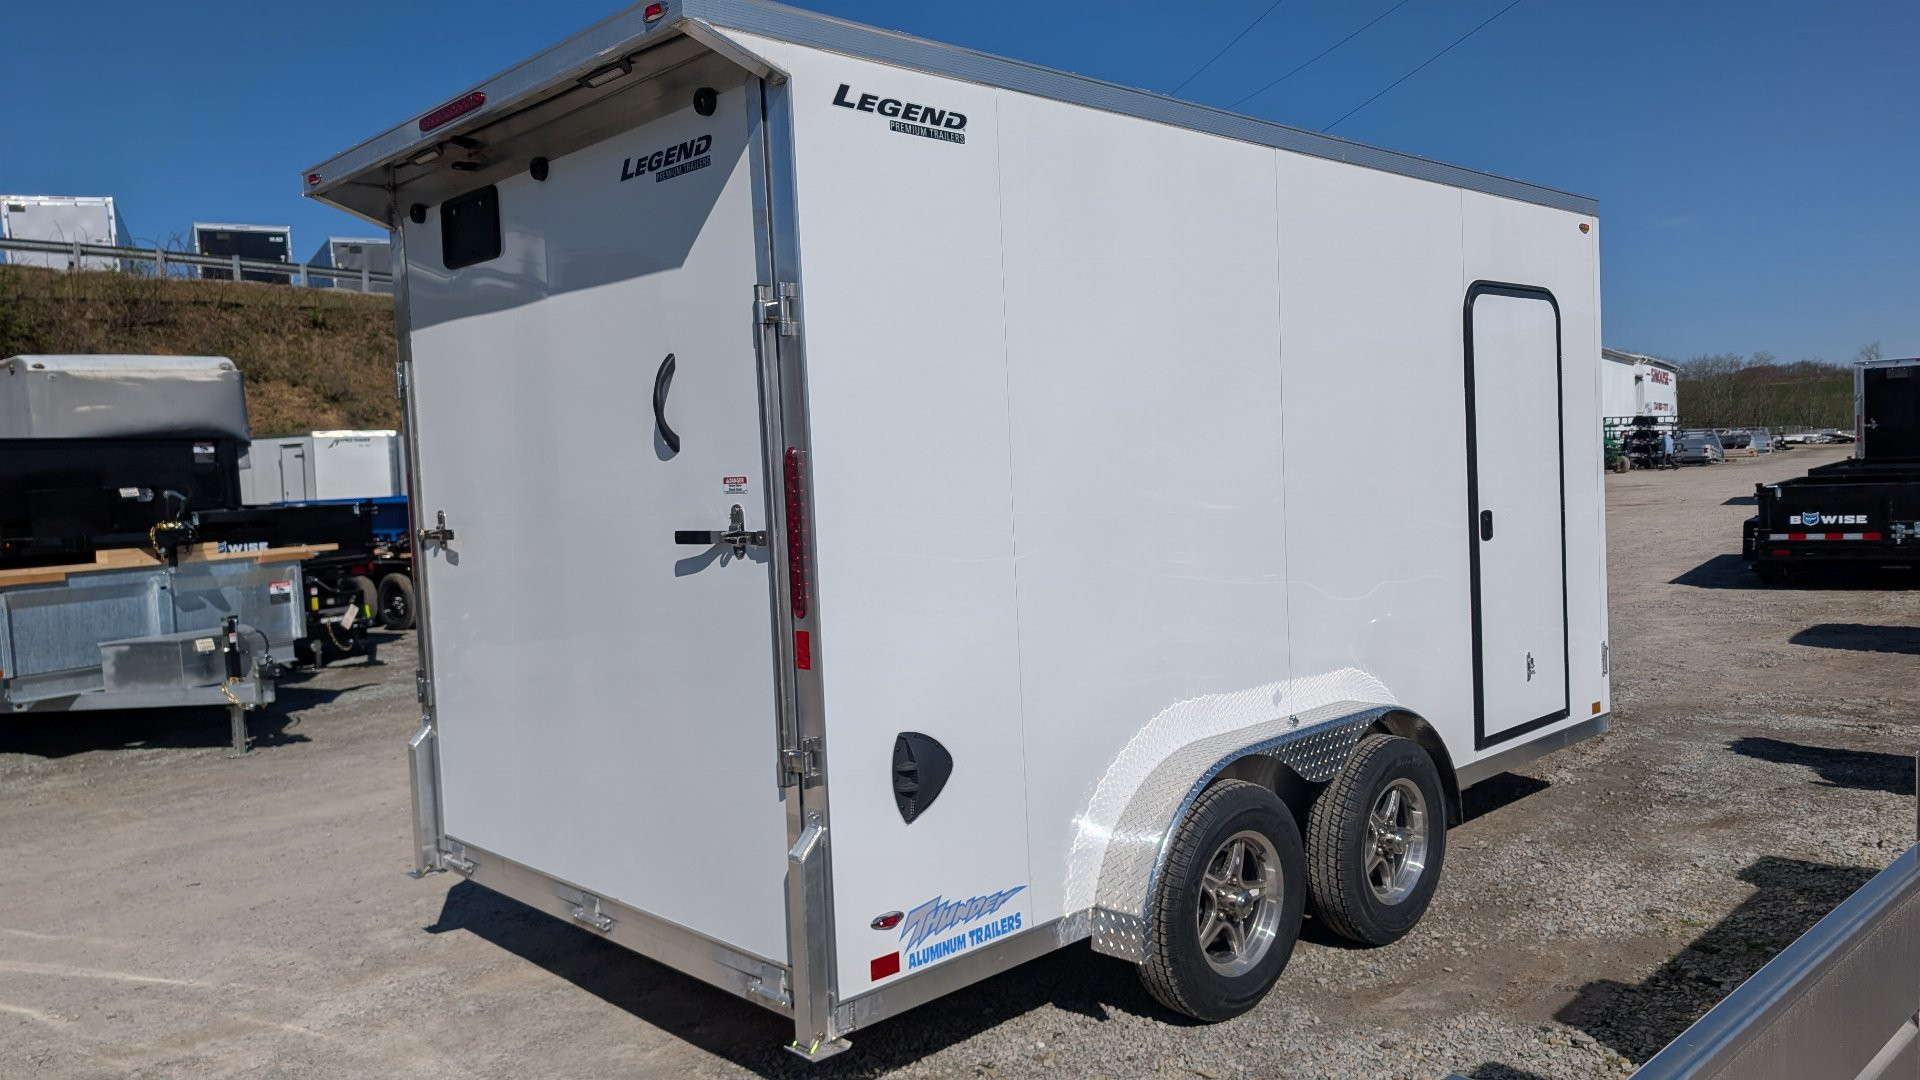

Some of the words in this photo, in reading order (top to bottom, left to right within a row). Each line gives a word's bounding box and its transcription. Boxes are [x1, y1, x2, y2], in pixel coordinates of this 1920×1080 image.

[832, 84, 967, 130] LEGEND
[890, 120, 928, 137] PREMIUM
[929, 128, 965, 144] TRAILERS
[620, 134, 713, 182] LEGEND
[656, 165, 683, 183] PREMIUM
[683, 156, 711, 173] TRAILERS
[217, 541, 269, 553] WISE
[899, 885, 1027, 955] THUNDER
[908, 934, 967, 970] ALUMINUM
[968, 912, 1022, 947] TRAILERS
